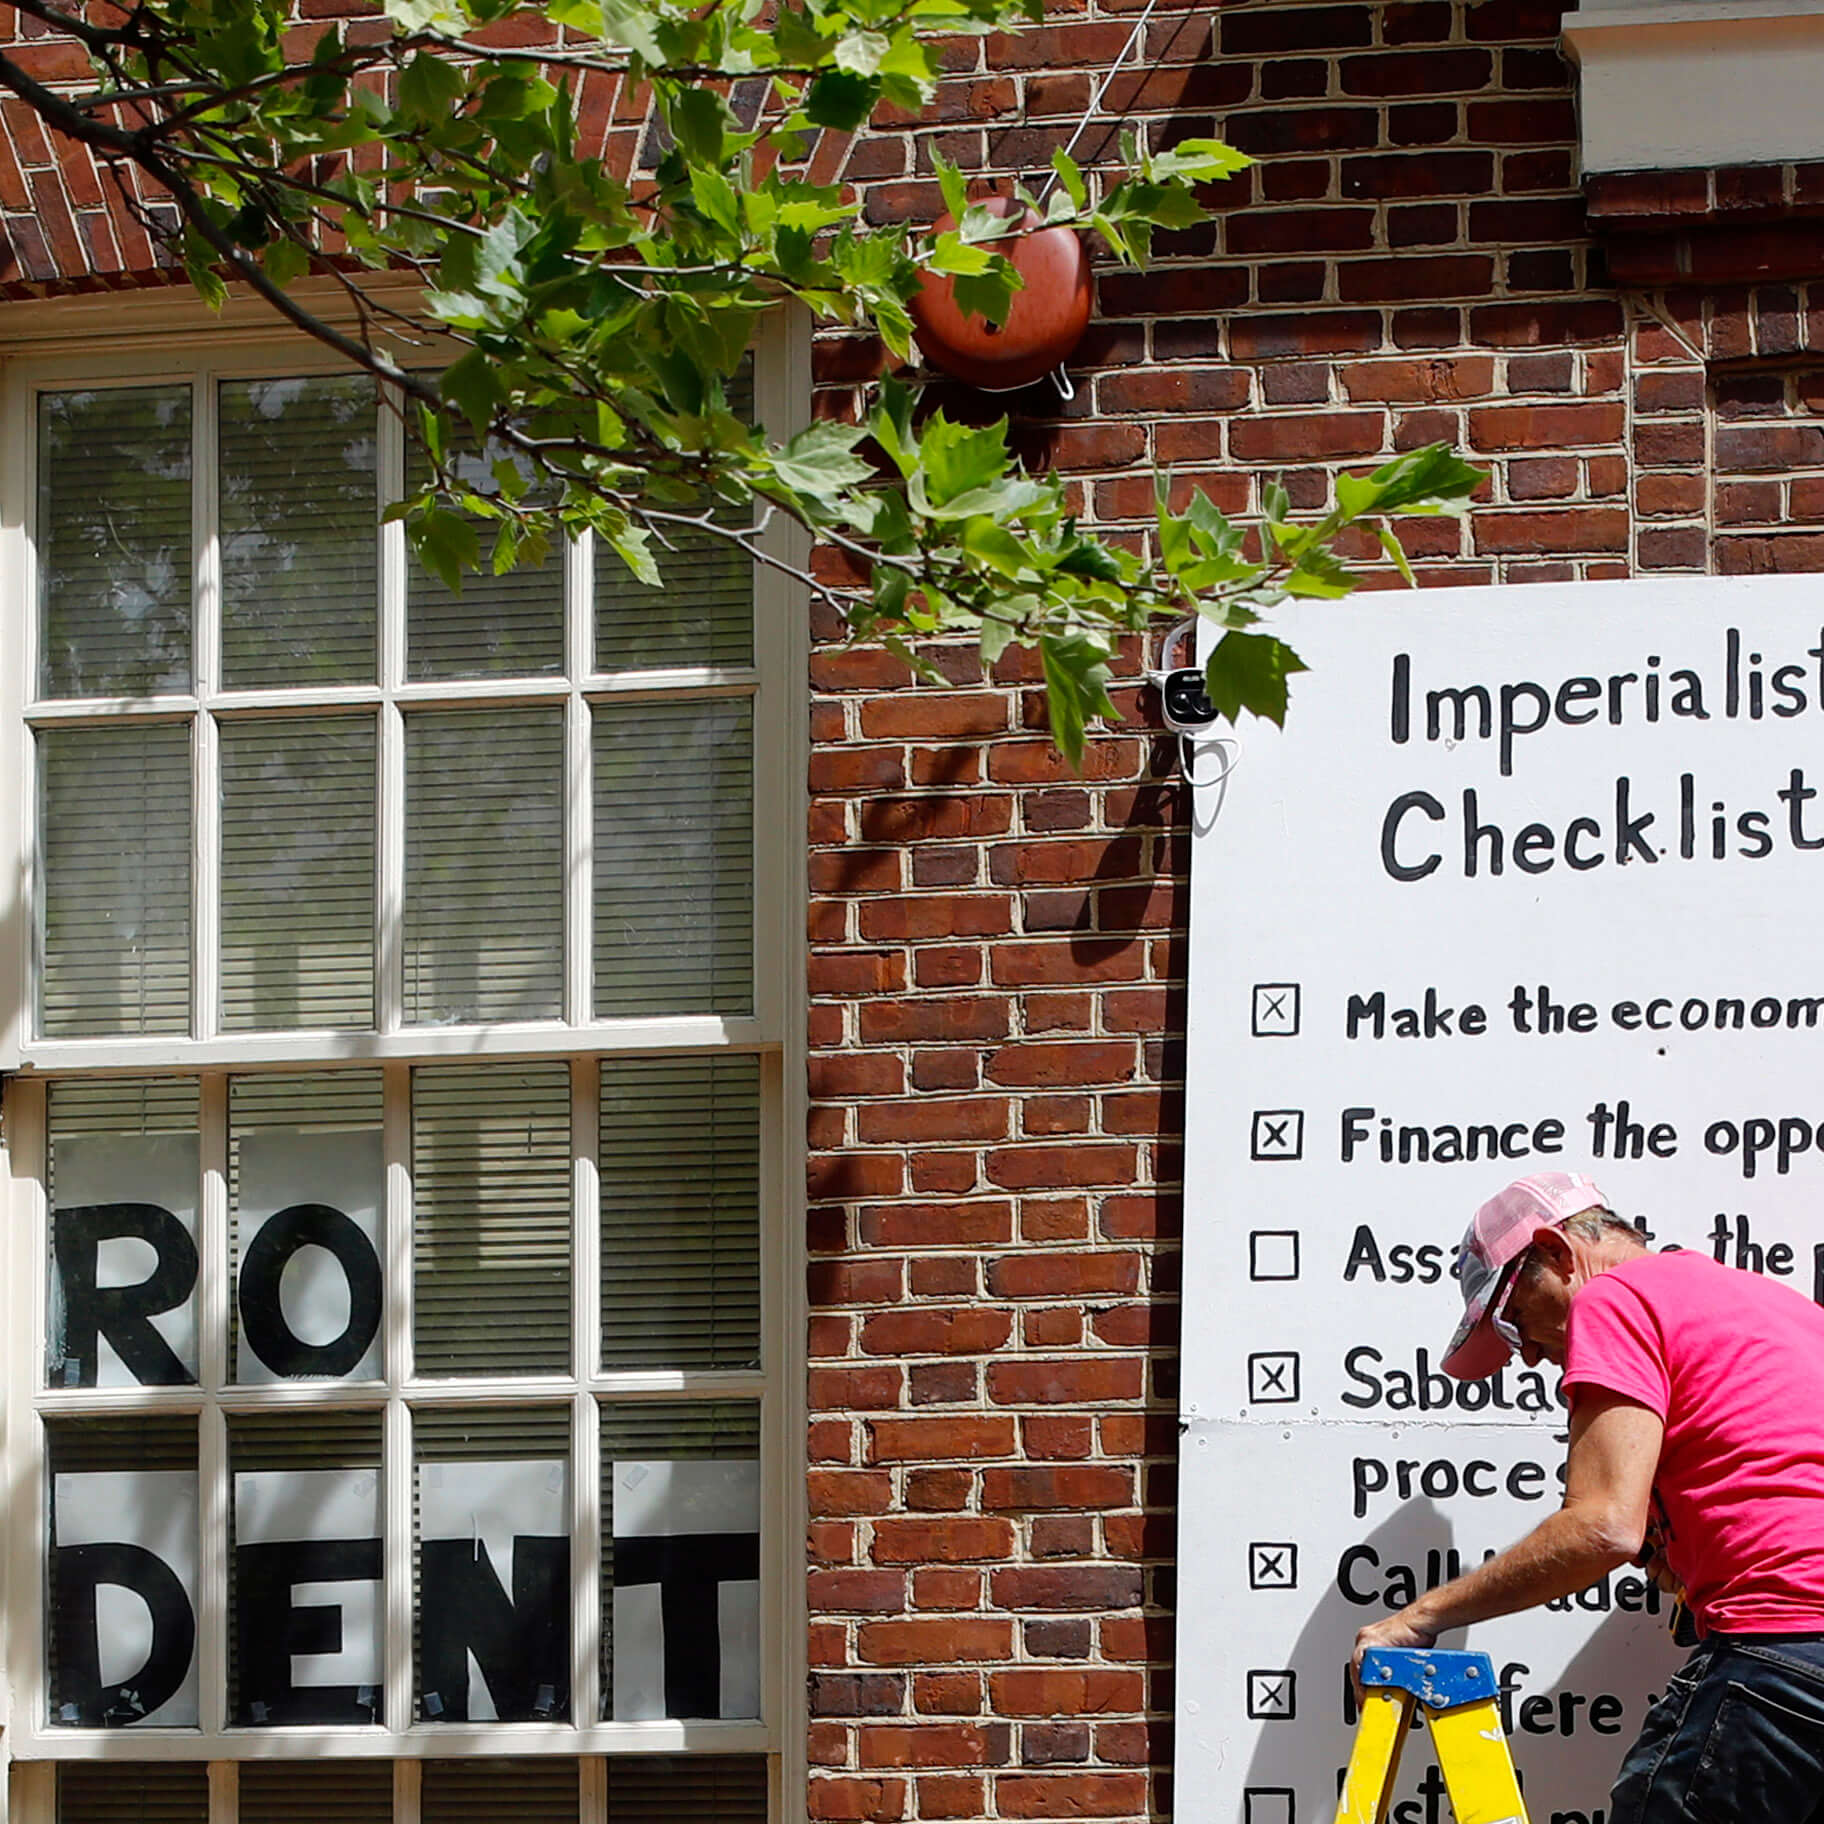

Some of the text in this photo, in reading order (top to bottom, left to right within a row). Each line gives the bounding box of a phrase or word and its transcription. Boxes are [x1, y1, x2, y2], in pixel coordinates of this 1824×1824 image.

[1347, 988, 1486, 1038] Make
[1509, 986, 1597, 1034] the
[1342, 1108, 1564, 1163] Finance
[1587, 1101, 1676, 1161] the
[1709, 1214, 1793, 1276] the
[1337, 1543, 1459, 1610] Call
[49, 1533, 760, 1726] DENT
